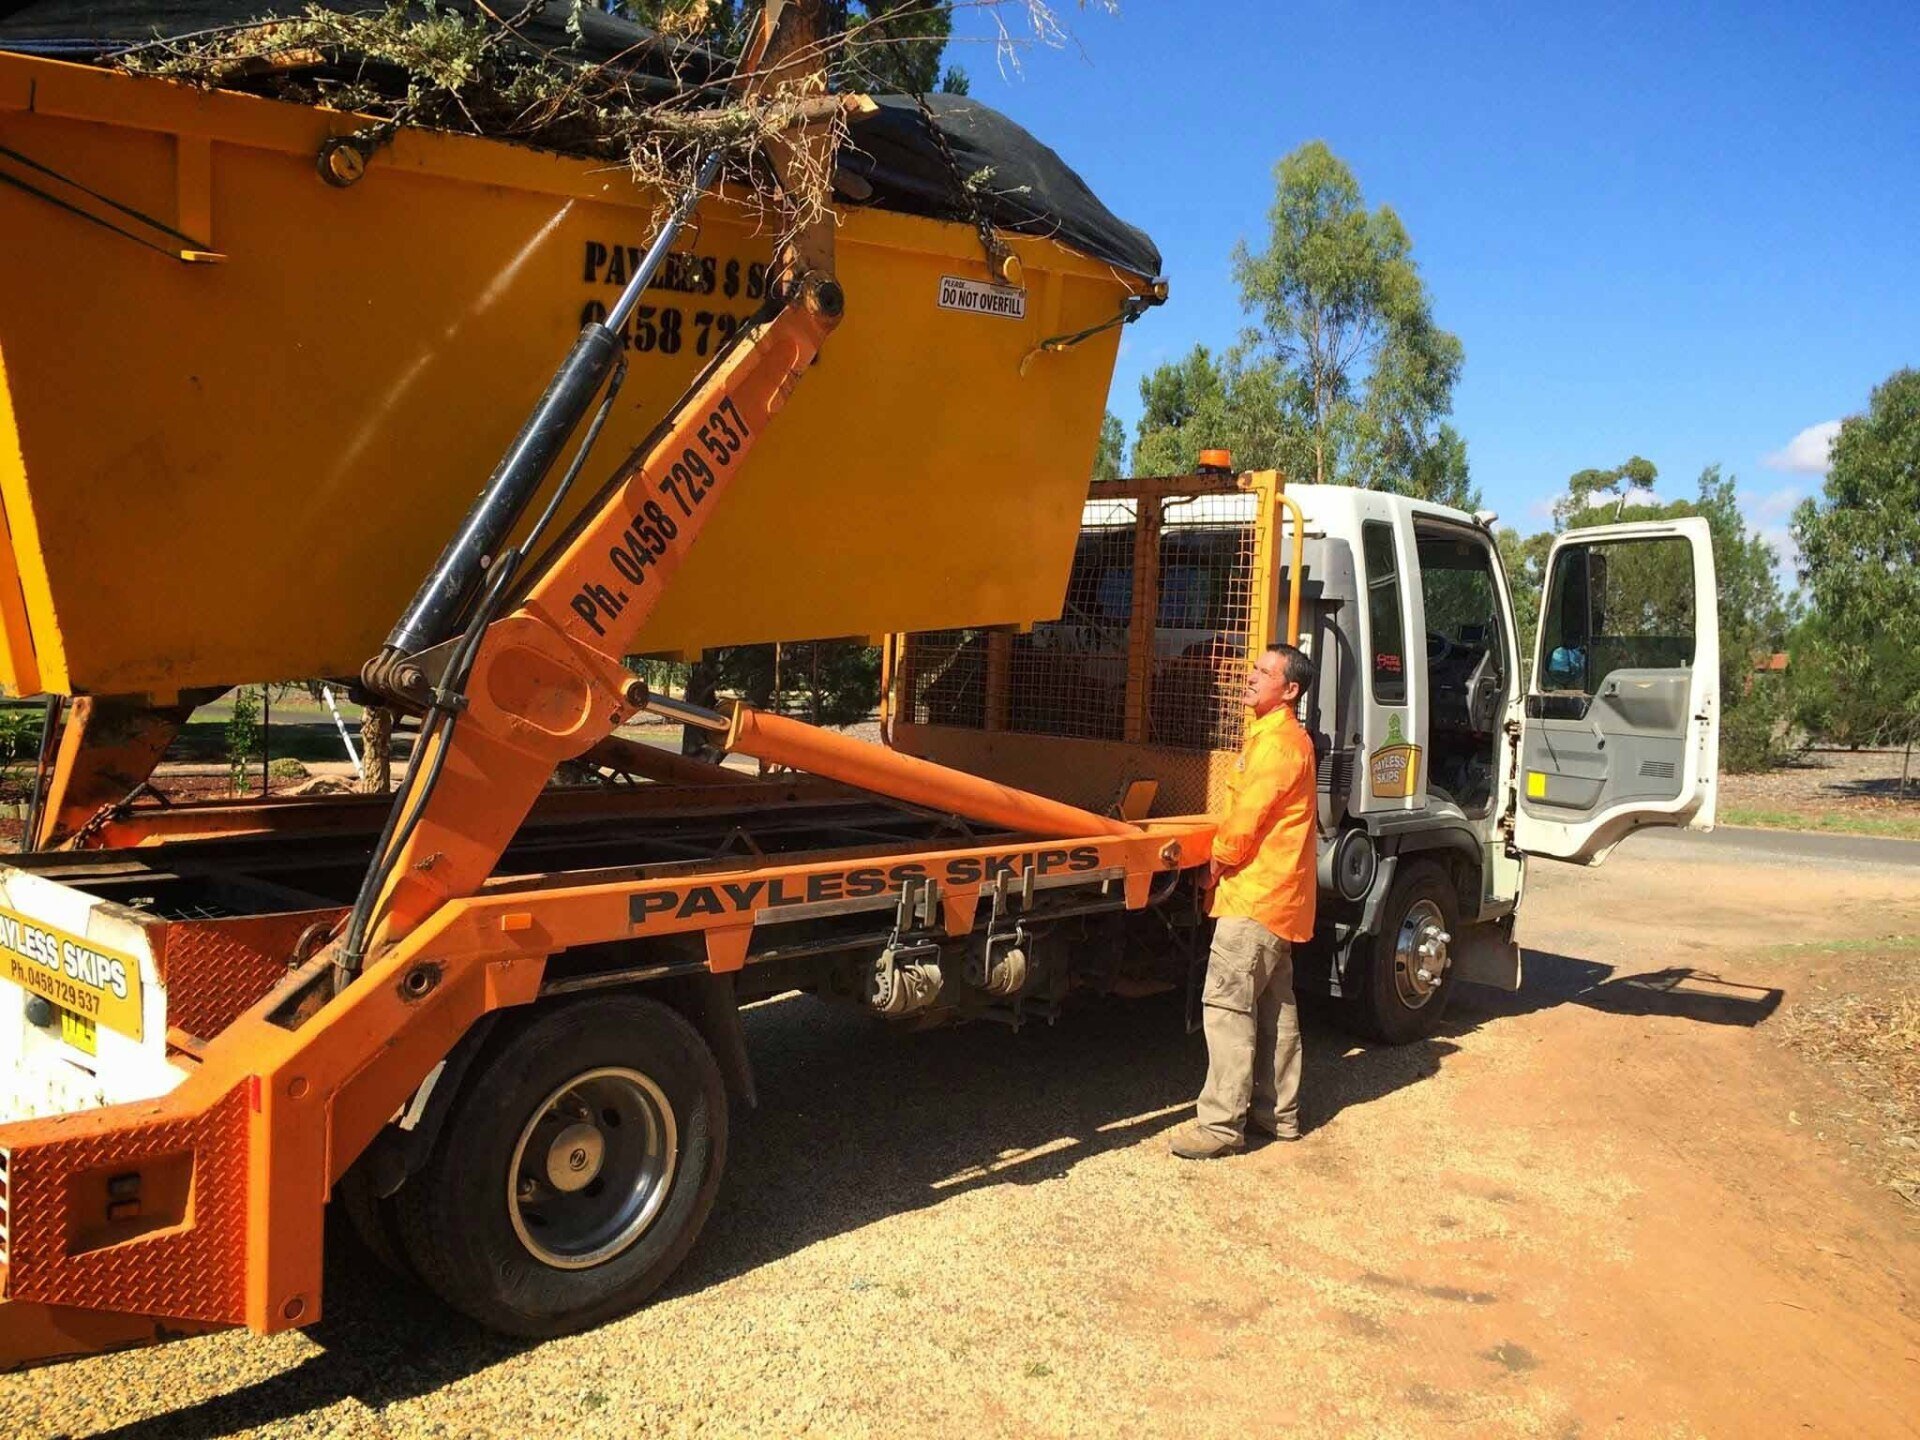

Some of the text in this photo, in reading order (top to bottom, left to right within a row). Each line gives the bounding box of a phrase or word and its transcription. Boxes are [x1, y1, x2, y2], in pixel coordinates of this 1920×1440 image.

[580, 300, 752, 356] 058 72
[942, 288, 1021, 315] DO NOT OVERFILL
[570, 396, 749, 637] Ph. 0458 729 537
[1376, 770, 1400, 784] SKIPS
[629, 846, 1100, 924] PAYLESS SKIPS
[0, 914, 128, 999] AYLESS SKIPS
[55, 979, 77, 1005] 729
[78, 987, 100, 1015] 537
